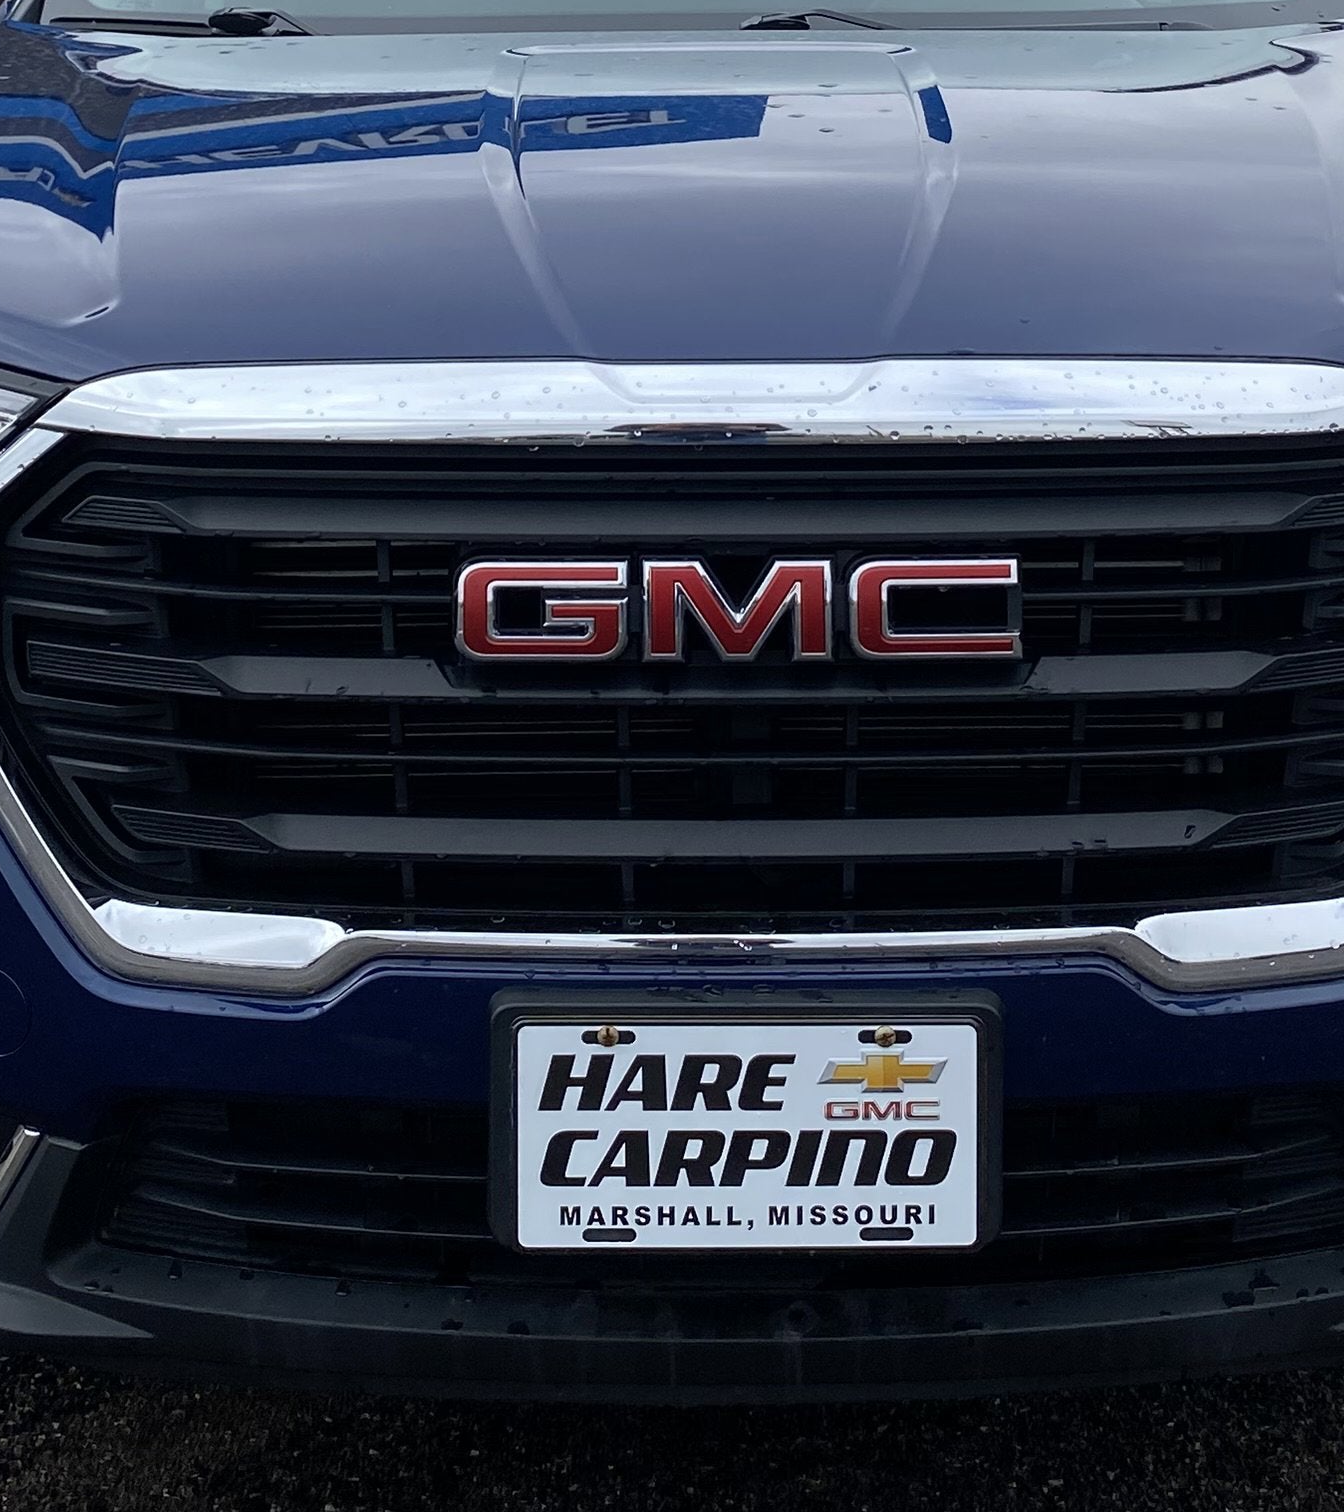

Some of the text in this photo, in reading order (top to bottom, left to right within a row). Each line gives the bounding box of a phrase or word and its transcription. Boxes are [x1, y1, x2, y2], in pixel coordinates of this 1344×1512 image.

[456, 557, 1023, 662] GMC
[537, 1052, 797, 1112] HARE
[822, 1099, 942, 1121] GMC
[539, 1128, 958, 1187] CARPINO
[559, 1203, 937, 1231] MARSHALL, MISSOURI
